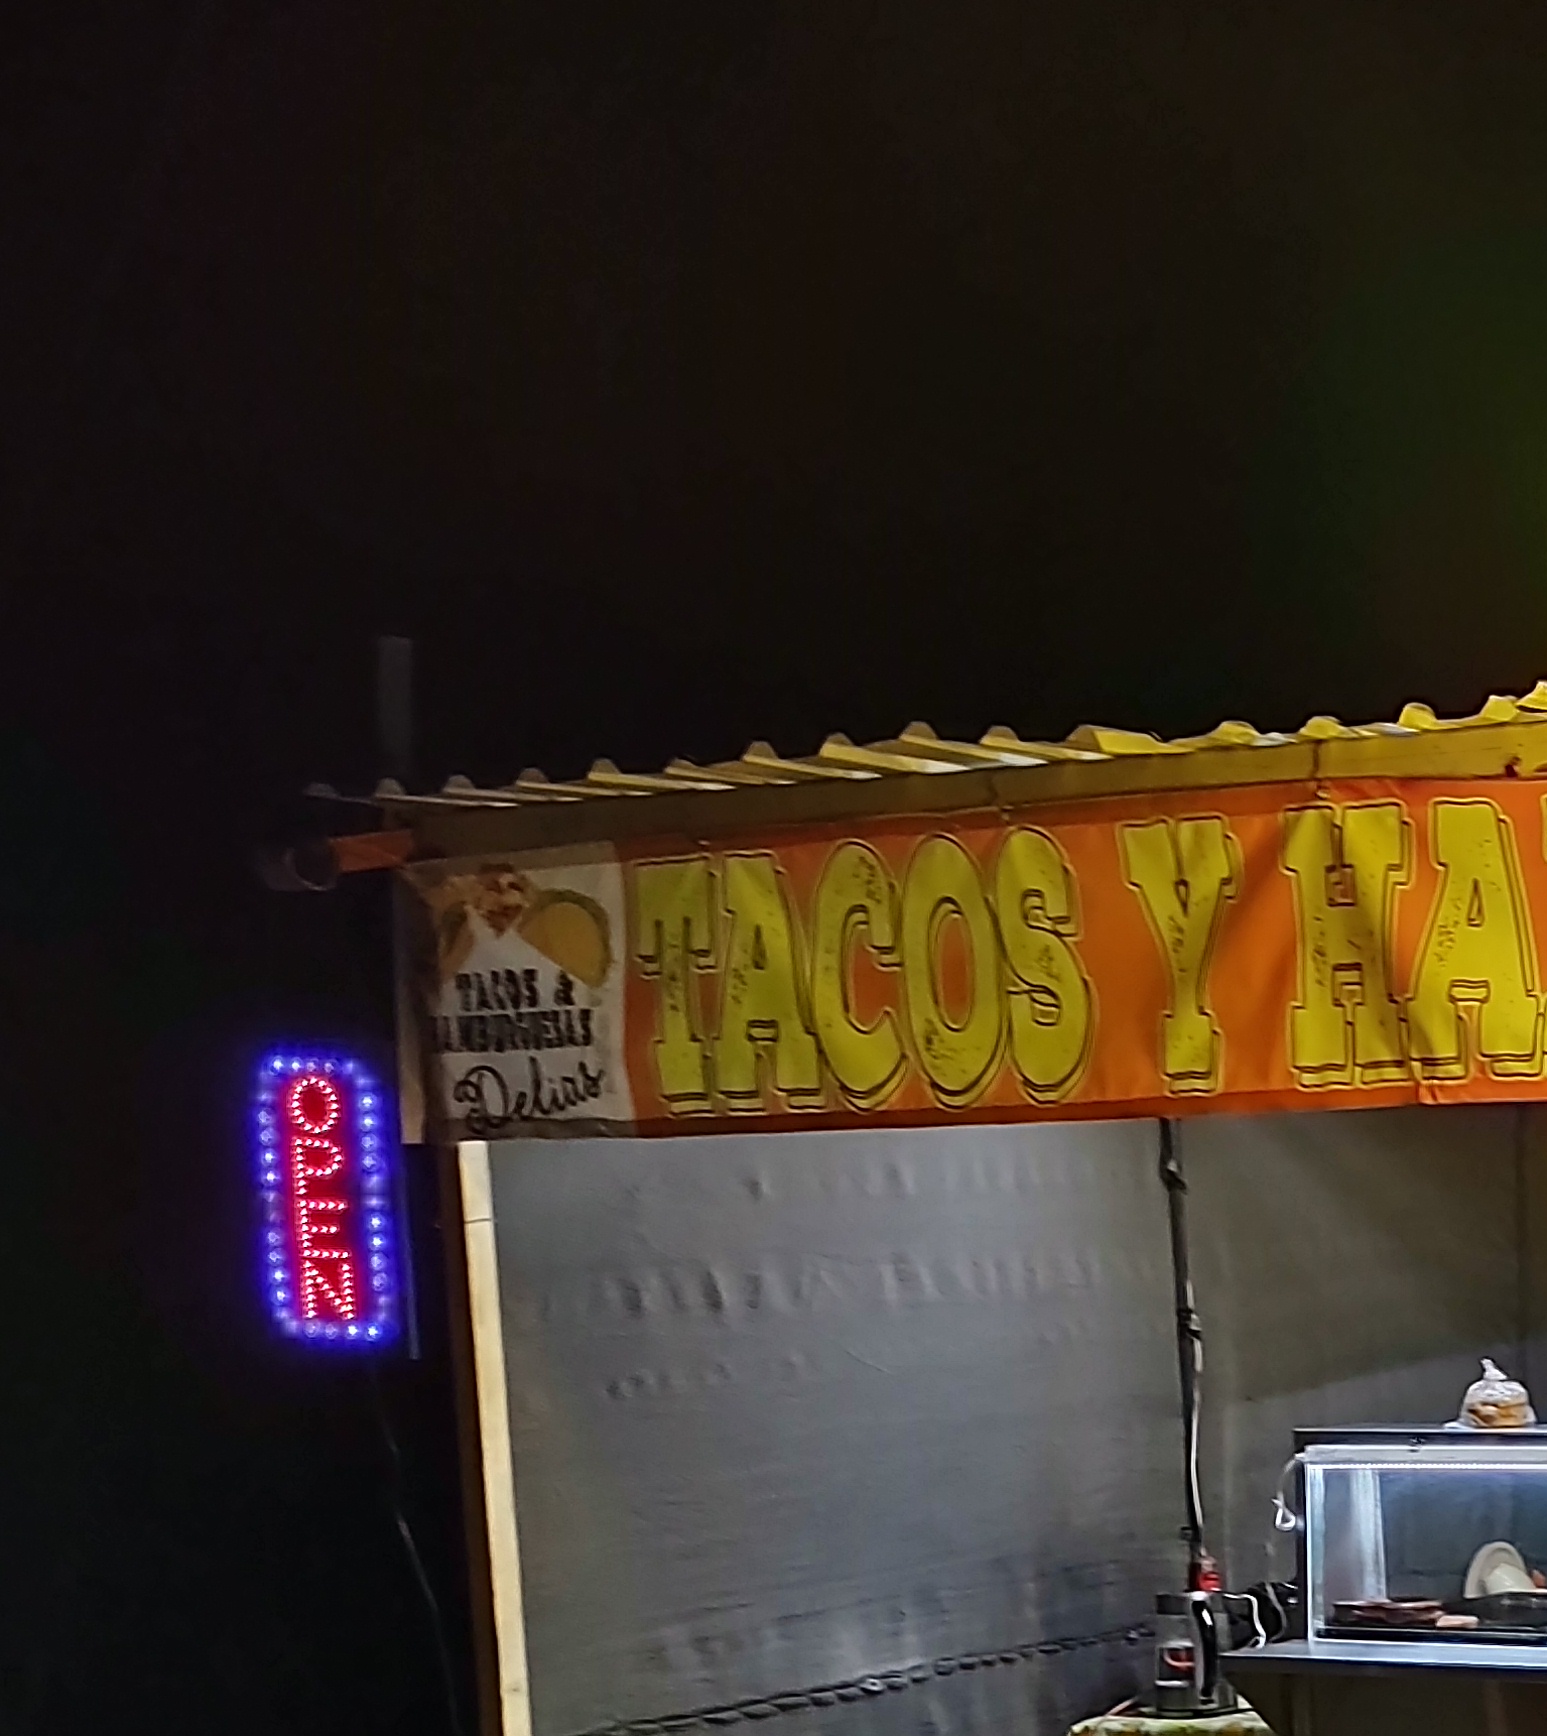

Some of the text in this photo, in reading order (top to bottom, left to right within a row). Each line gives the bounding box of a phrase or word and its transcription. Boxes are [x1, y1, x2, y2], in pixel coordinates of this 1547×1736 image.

[632, 825, 1098, 1118] TACOS
[1118, 813, 1242, 1096] Y
[286, 1075, 357, 1320] OPEN
